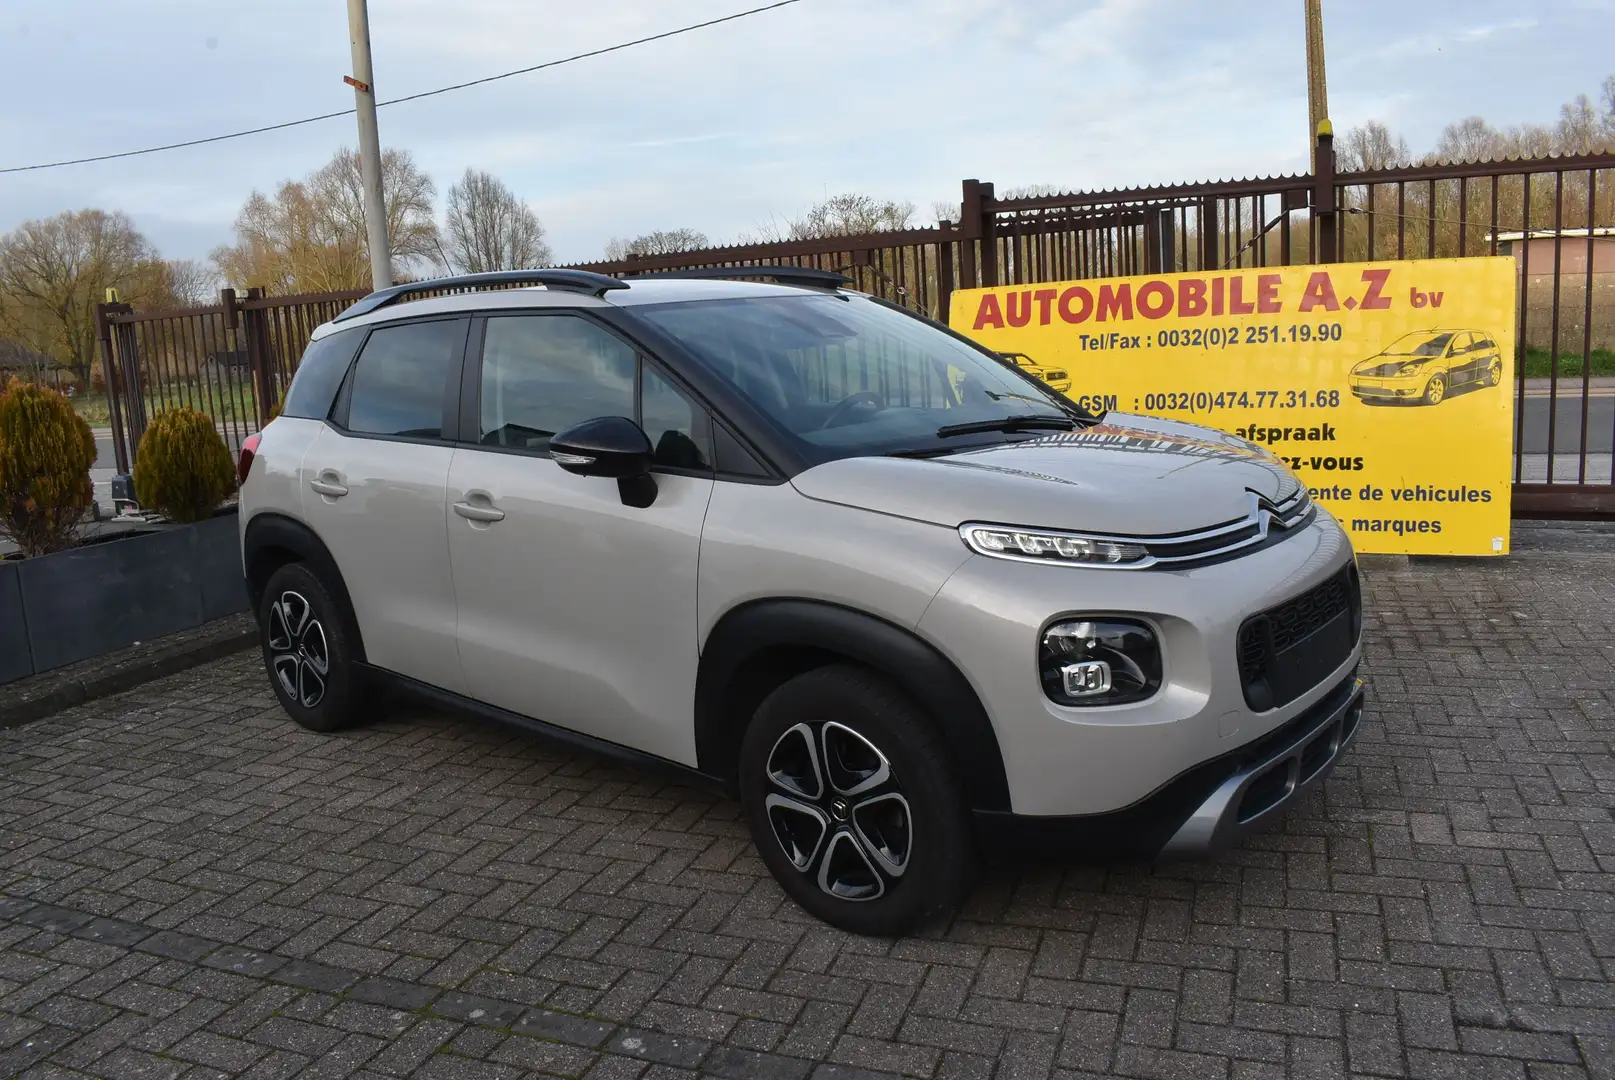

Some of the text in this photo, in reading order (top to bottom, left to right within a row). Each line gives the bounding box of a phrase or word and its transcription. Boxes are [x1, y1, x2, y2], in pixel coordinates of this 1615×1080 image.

[972, 268, 1444, 330] AUTOMOBILE A.Z bv
[1079, 332, 1141, 351] Tel/Fax
[1157, 327, 1239, 350] 0032(0)2
[1245, 323, 1342, 344] 251.19.90
[1079, 394, 1118, 412] GSM
[1145, 390, 1340, 414] 0032(0)474.77.31.68
[1235, 423, 1336, 445] afspraak
[1280, 456, 1364, 471] z-vous
[1307, 484, 1492, 503] ente de vehicules
[1352, 519, 1442, 536] marques
